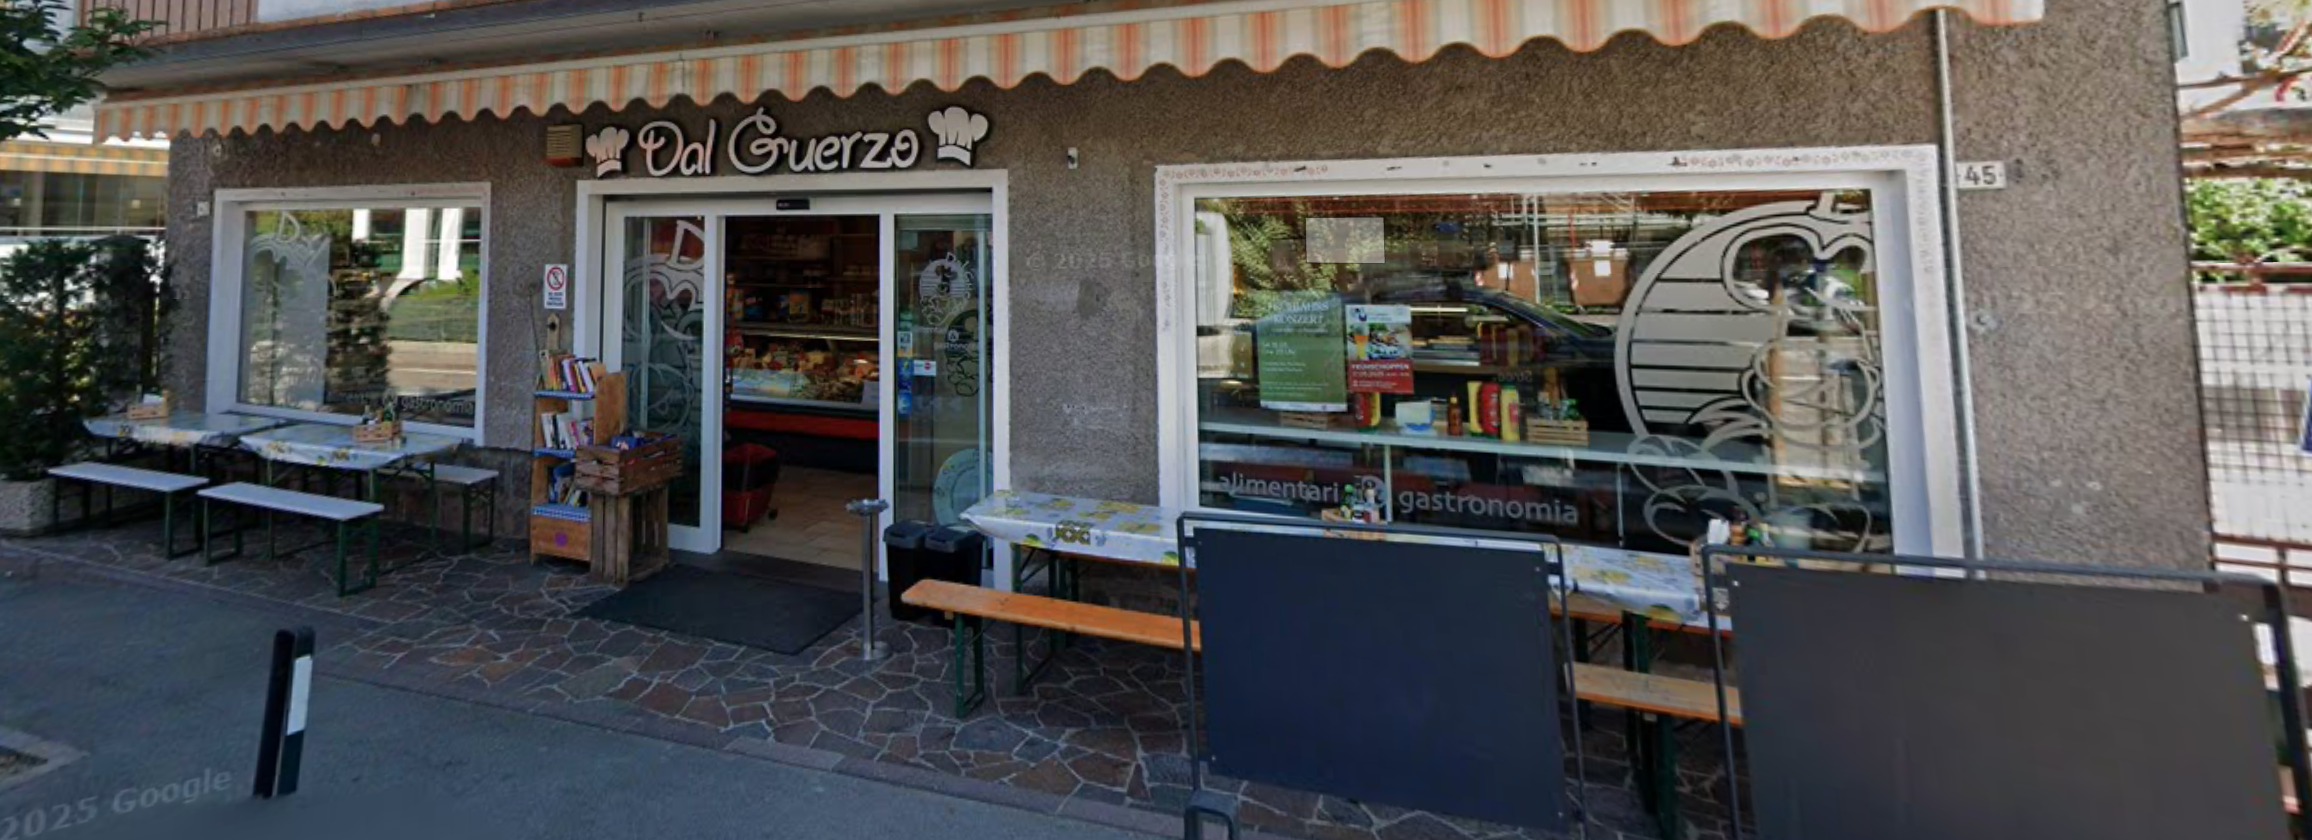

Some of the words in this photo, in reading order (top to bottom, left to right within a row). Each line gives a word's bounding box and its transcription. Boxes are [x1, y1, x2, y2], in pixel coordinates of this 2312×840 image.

[637, 118, 716, 177] Dal
[728, 107, 920, 174] Guerzo
[1964, 165, 1997, 186] 45
[1219, 471, 1339, 503] alimentari
[1398, 490, 1579, 525] gastronomia
